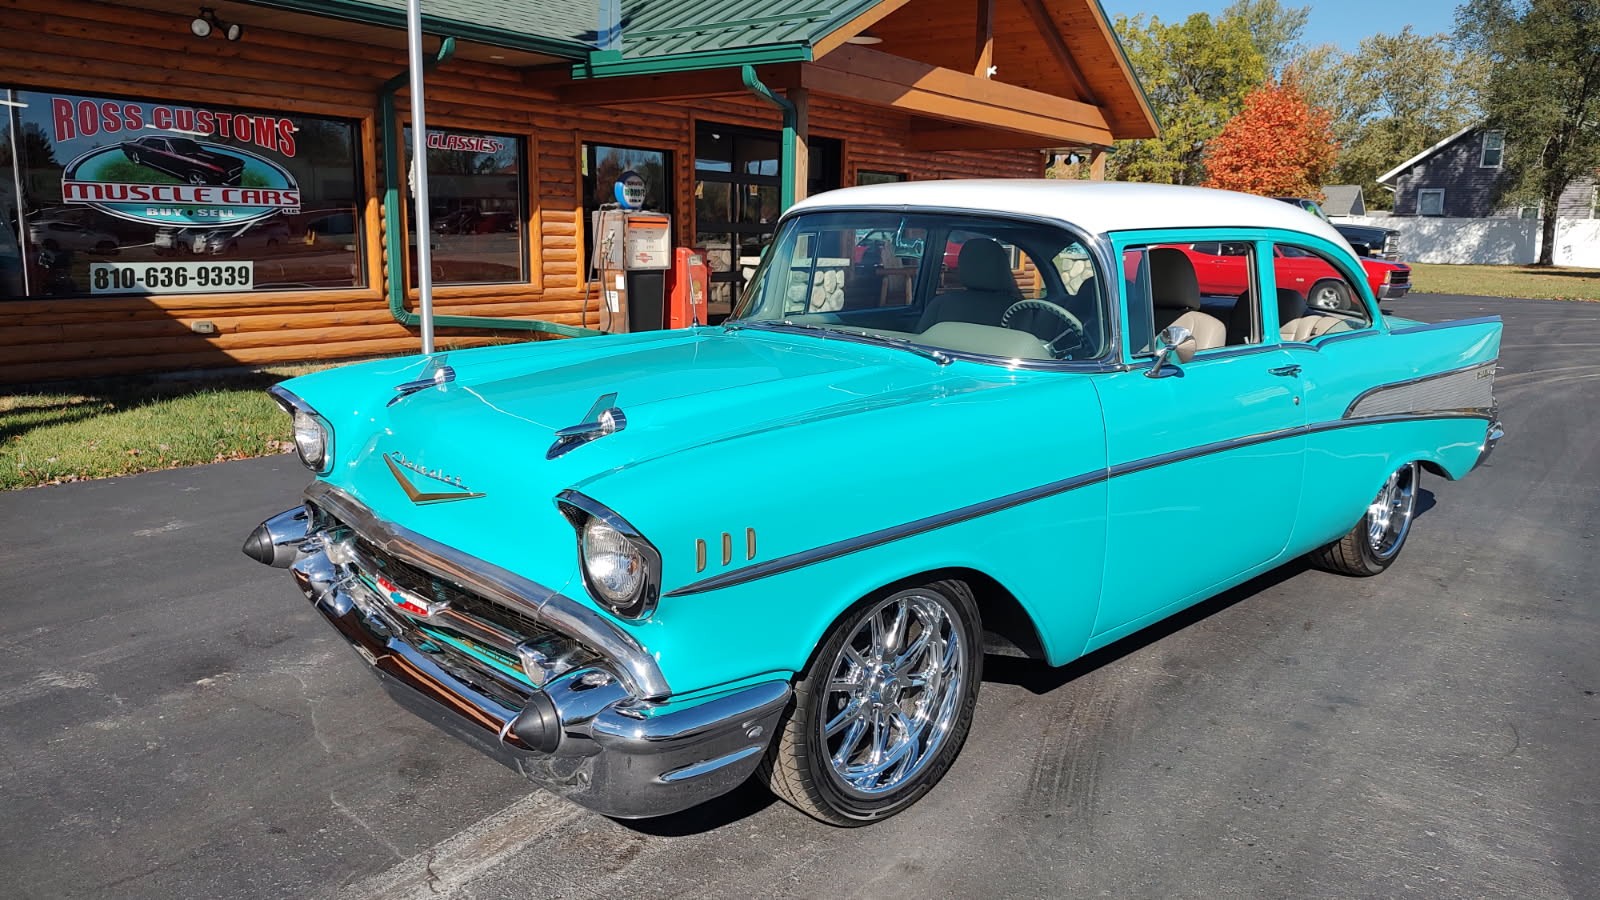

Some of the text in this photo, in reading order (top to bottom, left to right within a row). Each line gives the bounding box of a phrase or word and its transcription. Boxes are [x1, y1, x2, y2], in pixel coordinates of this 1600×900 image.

[52, 98, 296, 157] ROSS CUSTOMS
[427, 133, 497, 153] CLASSICS
[64, 183, 299, 206] MUSCLE CARS
[146, 207, 235, 217] BUY SELL
[94, 266, 250, 290] 810-636-9339
